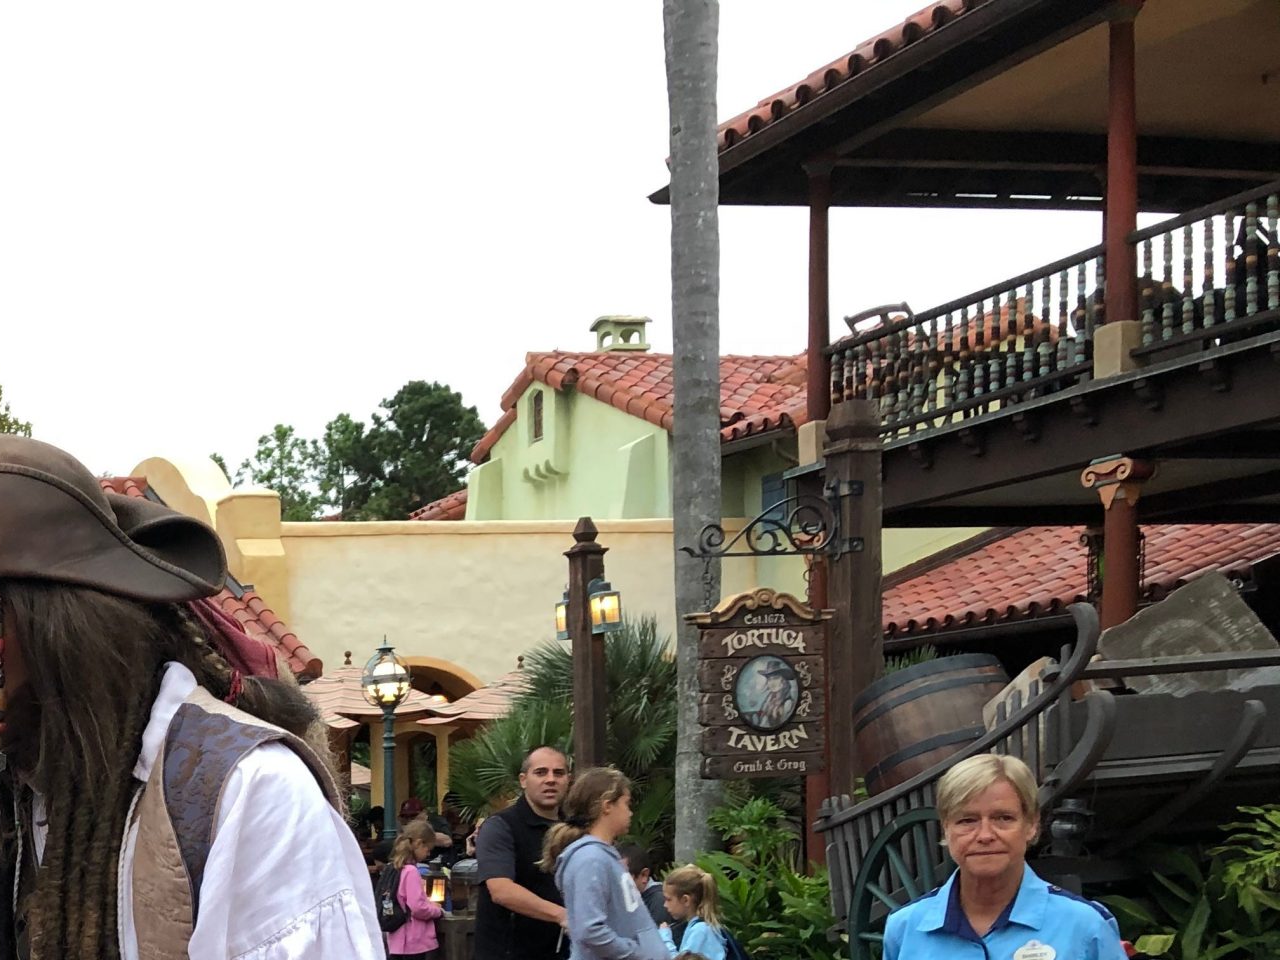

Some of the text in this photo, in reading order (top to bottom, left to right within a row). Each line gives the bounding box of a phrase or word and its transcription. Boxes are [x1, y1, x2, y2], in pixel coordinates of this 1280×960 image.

[727, 724, 809, 752] TAVERN
[733, 759, 807, 773] Grub & Grog
